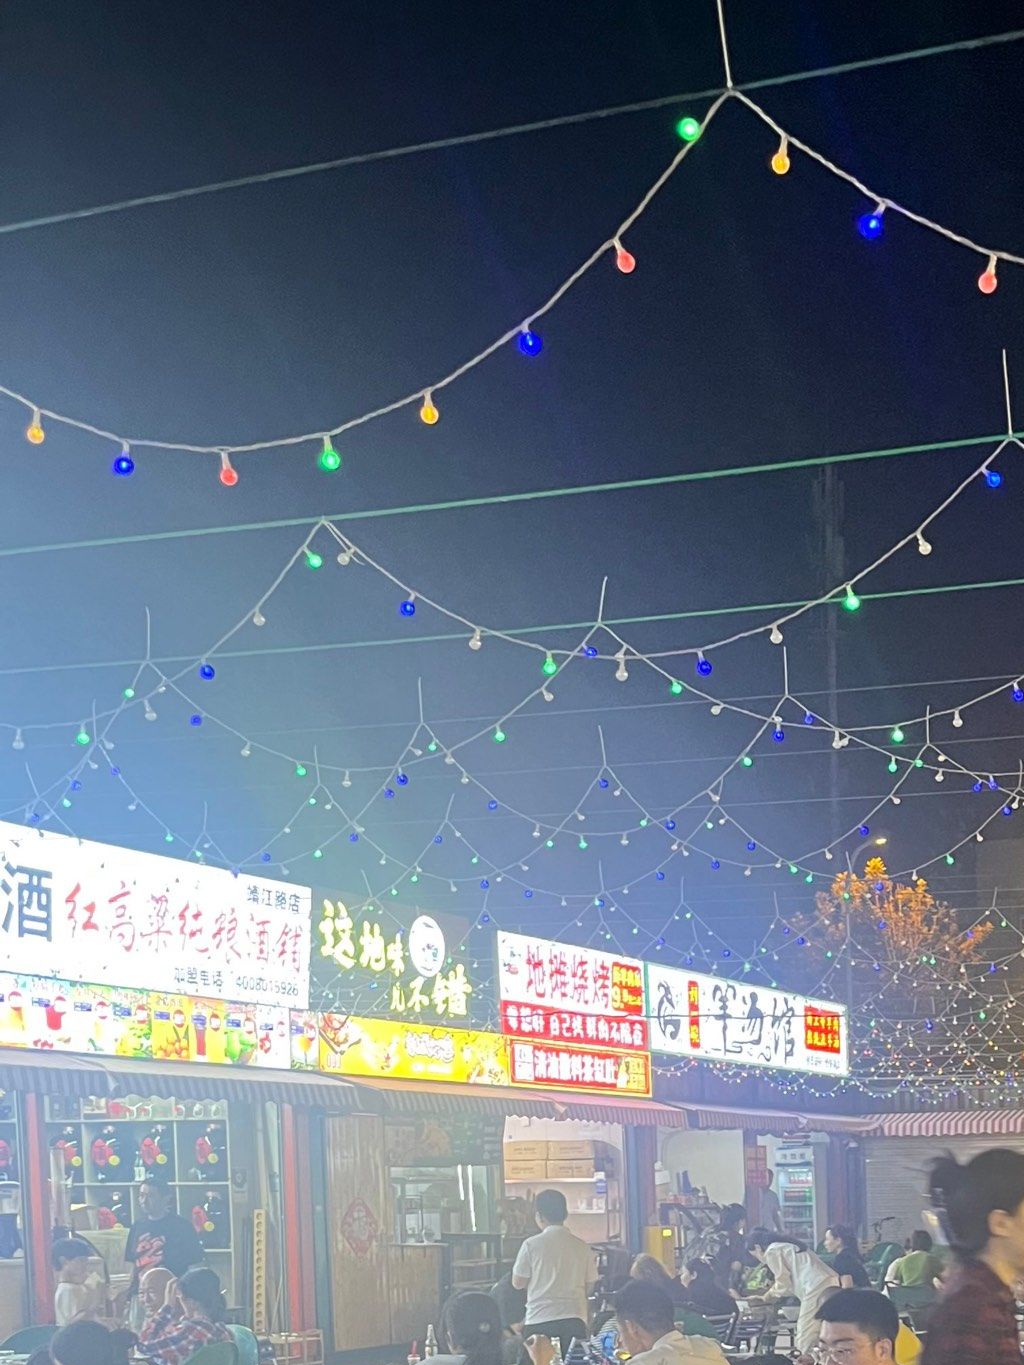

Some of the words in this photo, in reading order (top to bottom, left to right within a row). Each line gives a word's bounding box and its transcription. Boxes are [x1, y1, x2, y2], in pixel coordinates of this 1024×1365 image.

[0, 861, 52, 942] 酒
[526, 945, 610, 1009] 地摊烧烤
